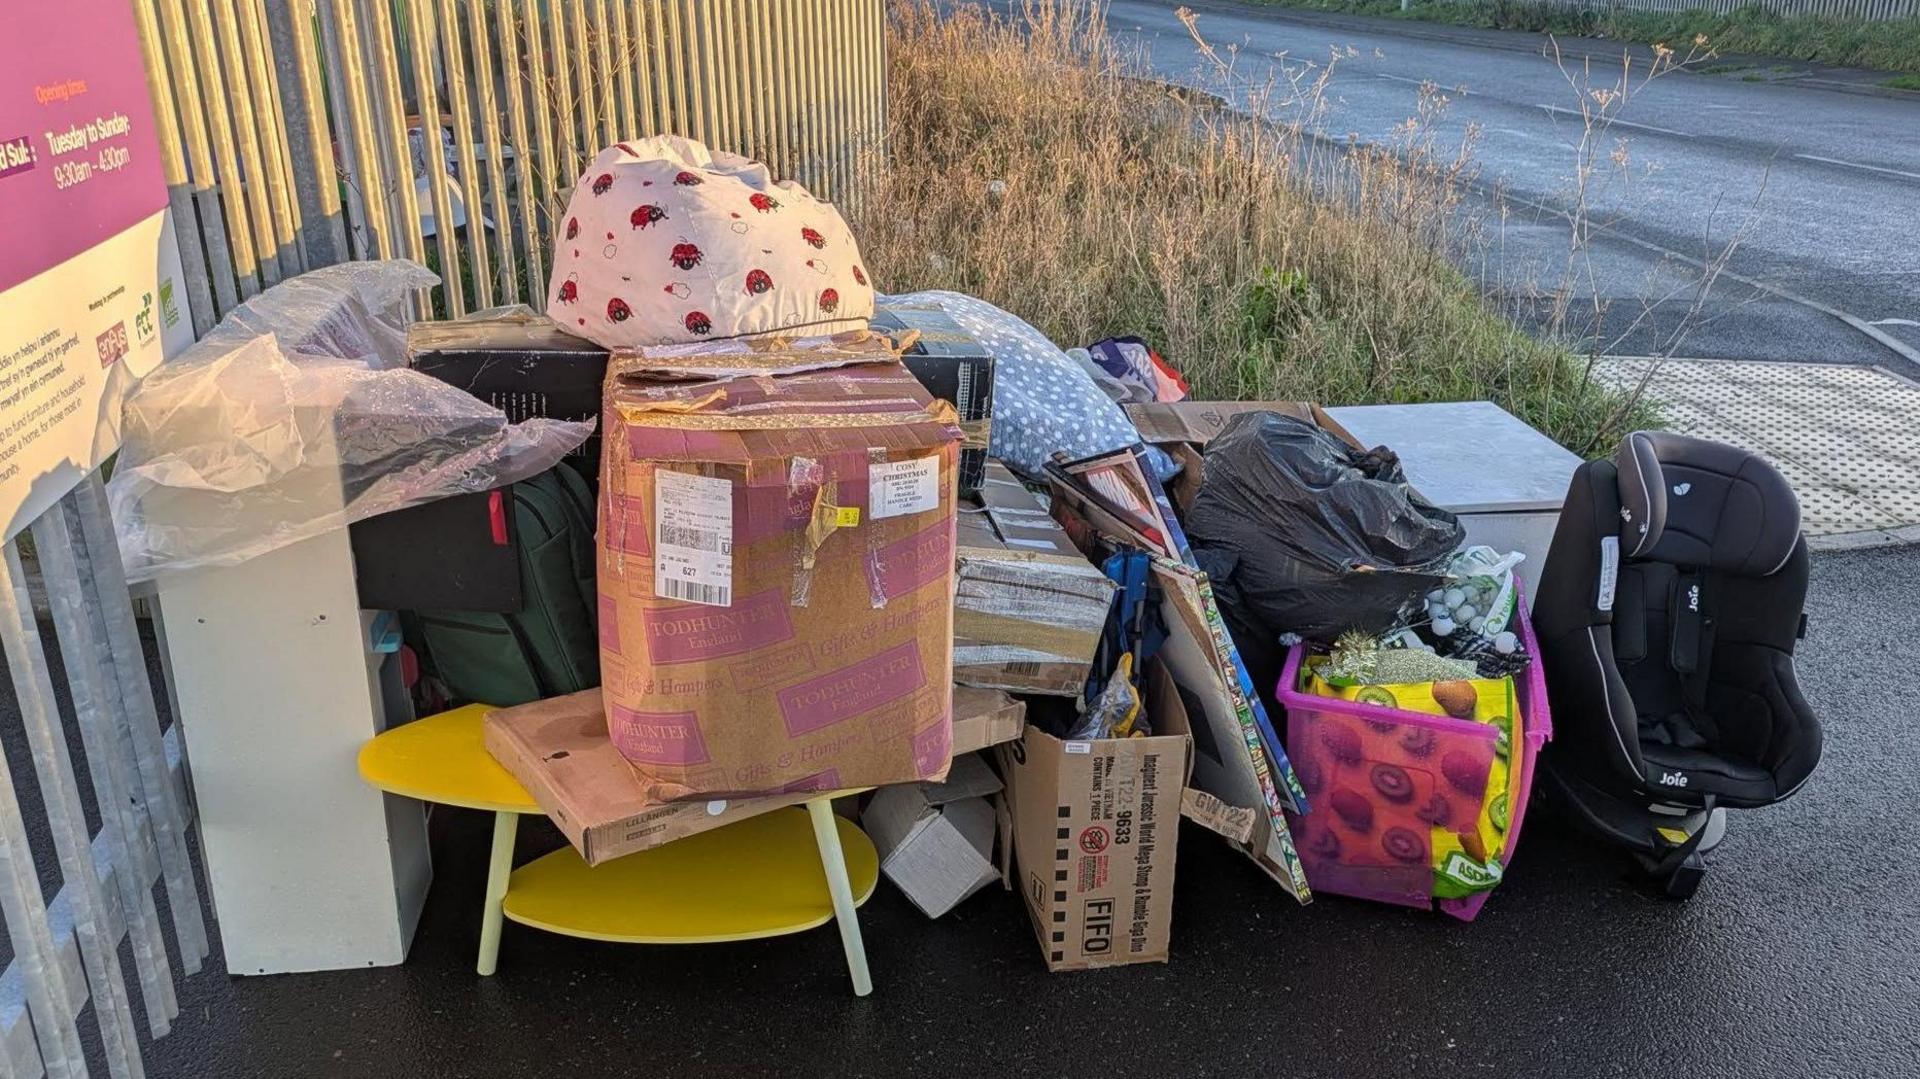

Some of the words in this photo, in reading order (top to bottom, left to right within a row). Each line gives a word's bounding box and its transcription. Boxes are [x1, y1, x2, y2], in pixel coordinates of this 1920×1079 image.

[36, 81, 70, 105] Opening
[45, 124, 88, 155] Tuesday
[86, 123, 98, 143] to
[54, 161, 92, 189] 9:30am
[883, 469, 928, 482] CHRISTMAS
[896, 461, 917, 472] COSY
[682, 566, 697, 577] 627
[1688, 585, 1700, 613] Joie
[650, 605, 776, 637] TODHUNTER
[688, 629, 743, 649] England
[661, 678, 724, 698] Hampers
[791, 656, 911, 710] TODHUNTER
[736, 761, 772, 784] Gifts
[1092, 757, 1103, 791] CONTAINS
[1140, 755, 1159, 790] Imaginext
[1660, 771, 1688, 788] Joie
[1091, 800, 1101, 821] PIECE
[1104, 789, 1113, 819] VIETNAM
[1141, 792, 1158, 821] Jurassic
[1139, 823, 1155, 843] World
[1135, 845, 1154, 864] Mega
[1134, 865, 1152, 887] Stomp
[1133, 896, 1150, 920] Rumble
[1085, 901, 1111, 952] FIFO
[1130, 921, 1147, 936] Giga
[1131, 937, 1146, 952] Dino
